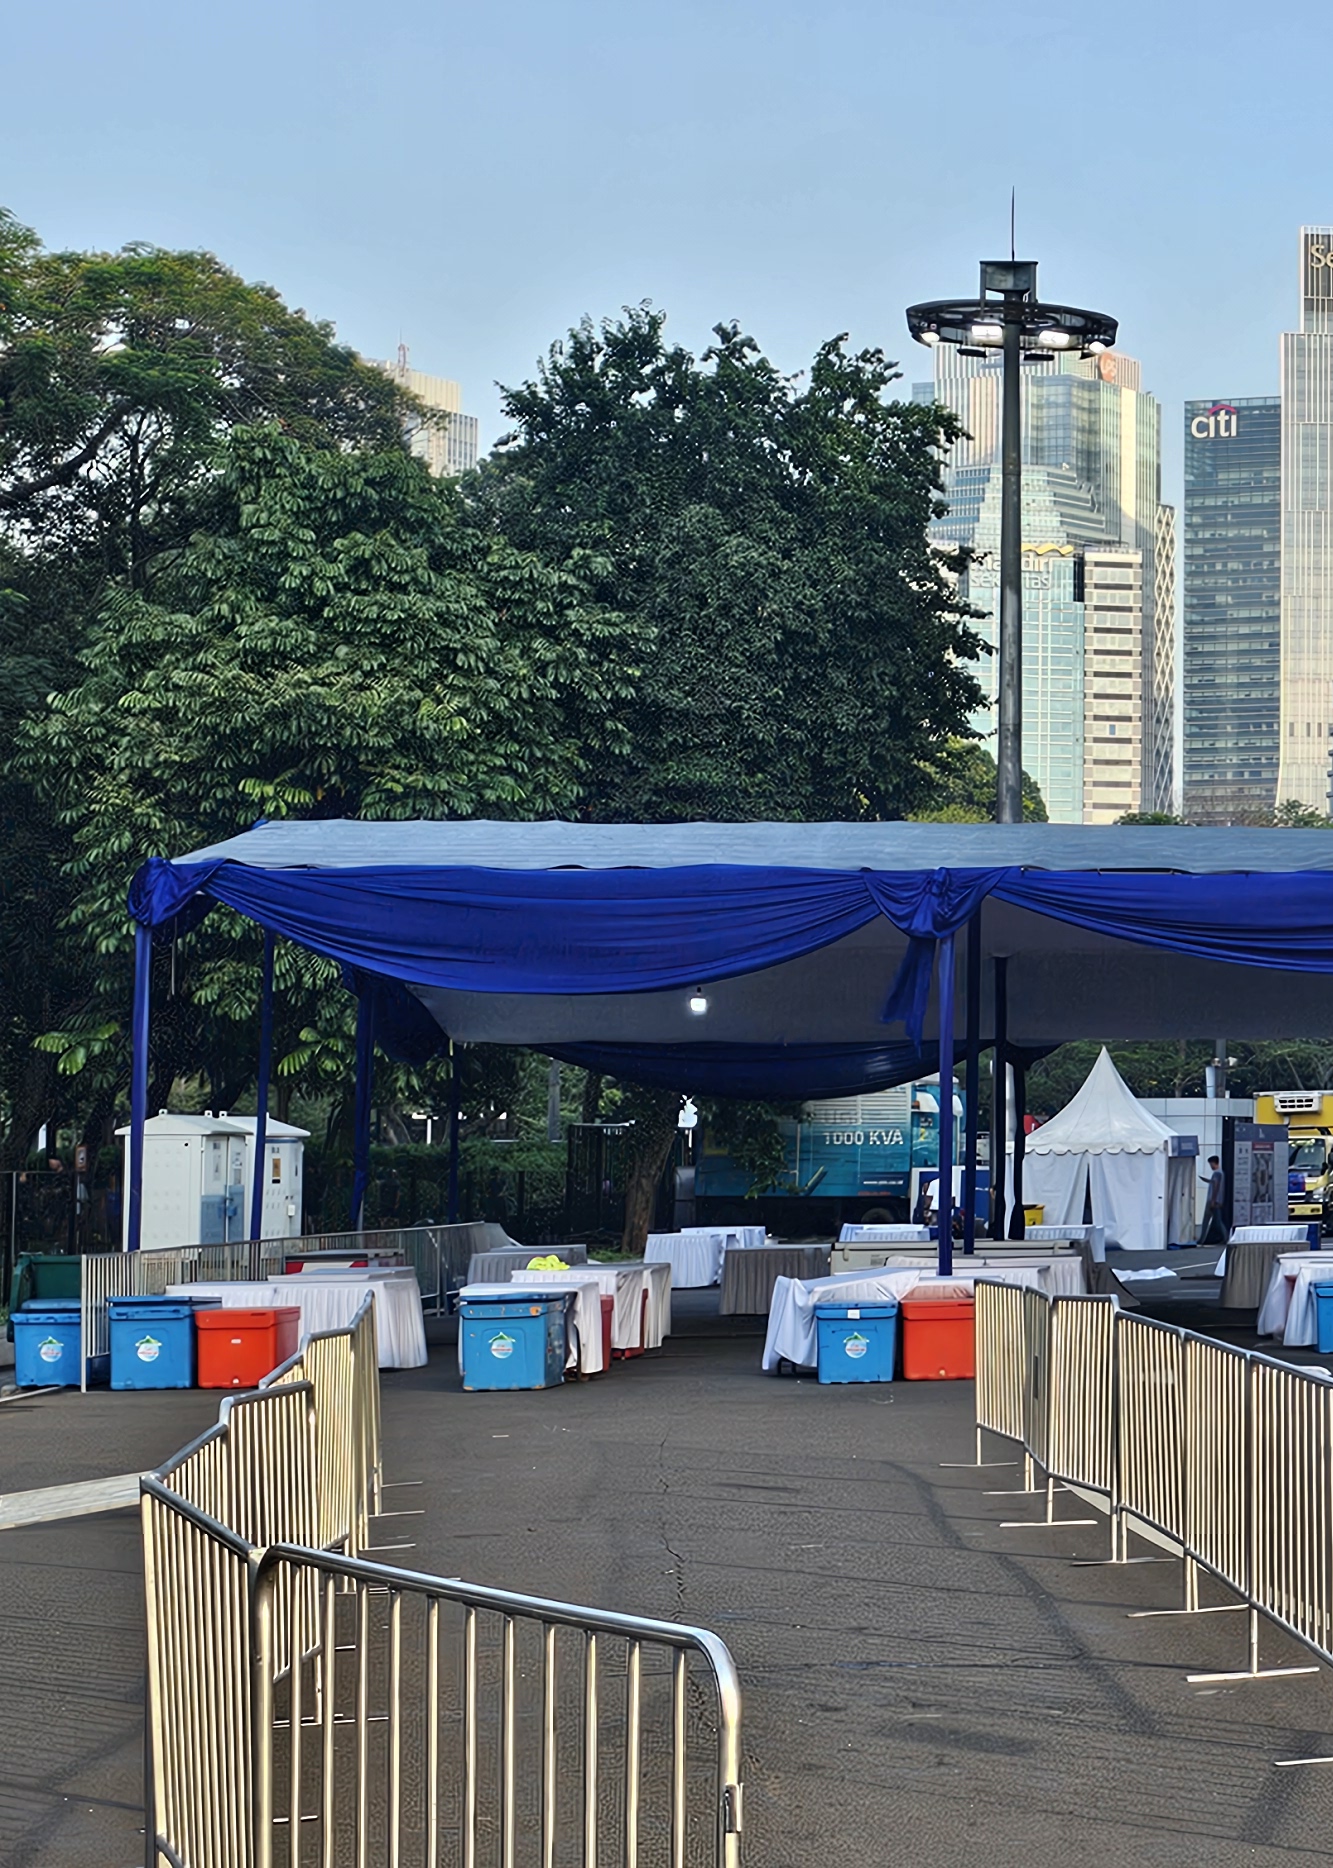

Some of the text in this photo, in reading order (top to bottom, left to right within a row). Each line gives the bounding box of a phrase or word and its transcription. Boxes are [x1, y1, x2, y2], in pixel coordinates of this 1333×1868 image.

[1191, 408, 1237, 438] citi
[822, 1131, 864, 1146] 1000
[869, 1129, 904, 1146] KVA
